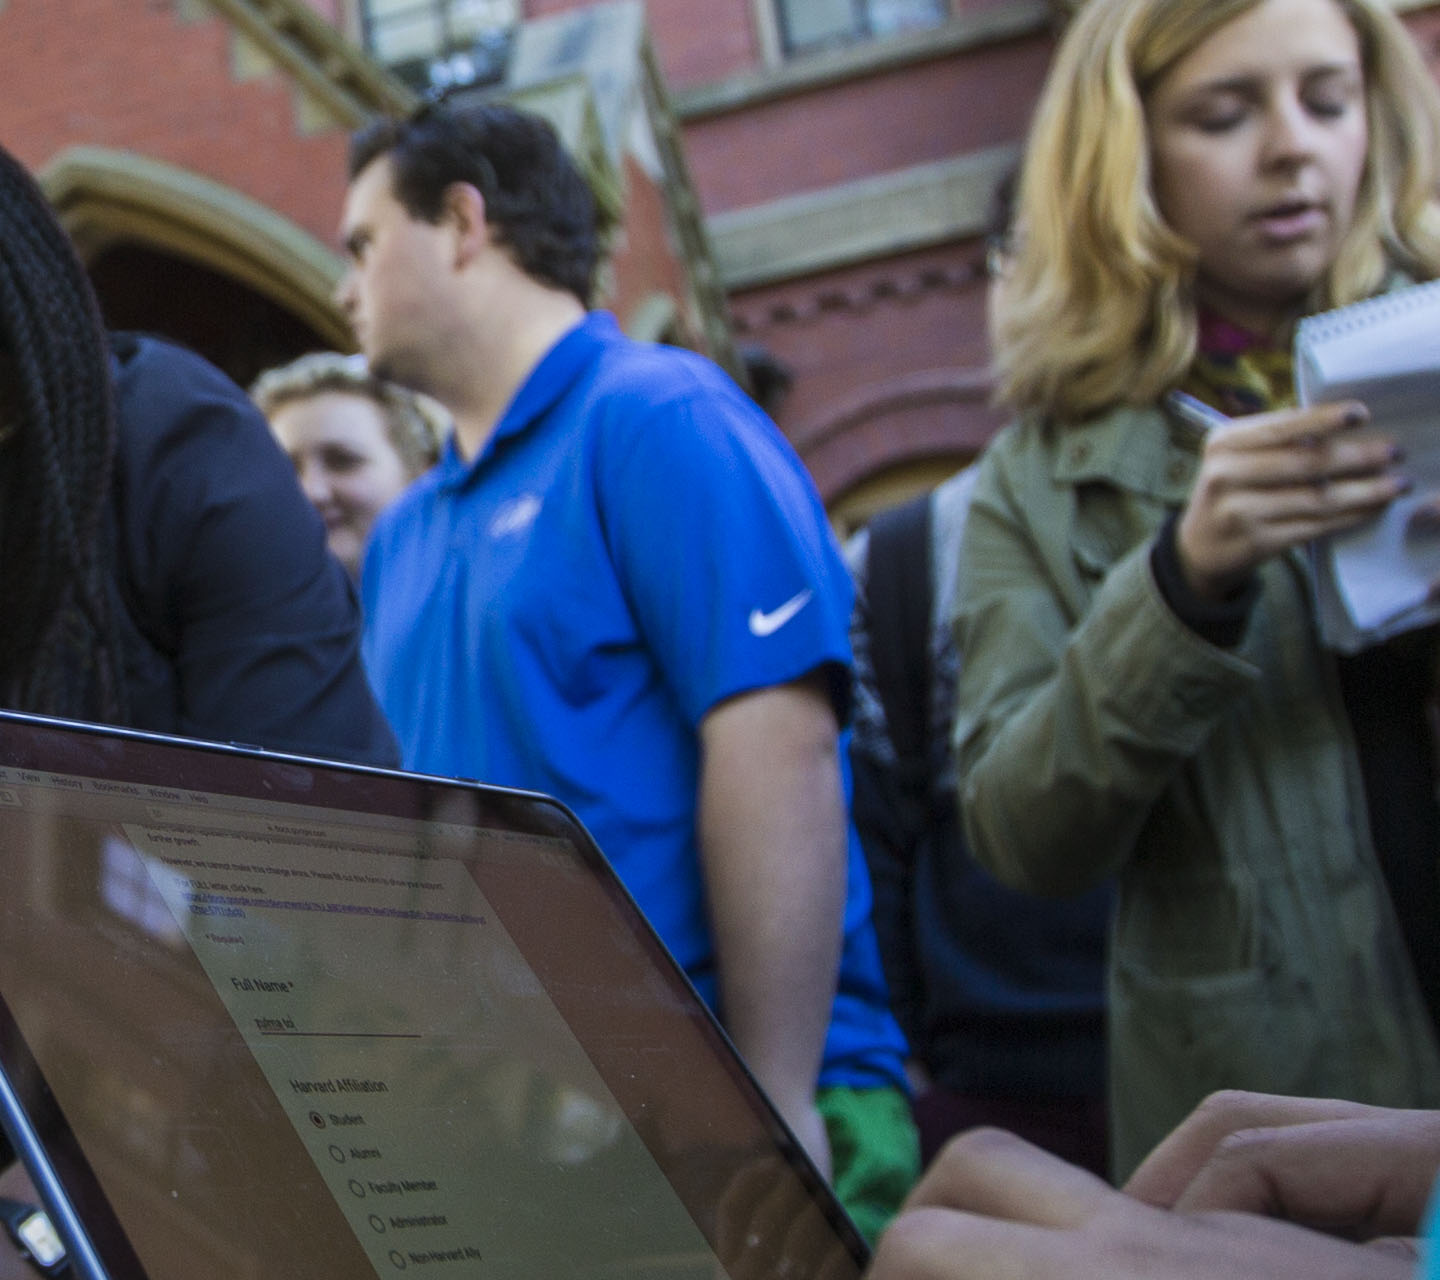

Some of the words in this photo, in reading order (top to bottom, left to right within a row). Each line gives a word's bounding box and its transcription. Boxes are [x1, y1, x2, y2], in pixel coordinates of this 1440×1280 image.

[18, 772, 40, 782] View
[50, 776, 83, 790] History
[231, 978, 254, 990] Full
[254, 979, 289, 992] Name
[290, 1080, 336, 1092] Harvard
[335, 1080, 387, 1092] Affiliation
[329, 1114, 364, 1124] Student
[349, 1148, 381, 1158] Alumni
[369, 1181, 402, 1195] Faculty
[401, 1180, 438, 1191] Member
[389, 1214, 448, 1228] Administrator
[463, 1247, 482, 1260] Ally
